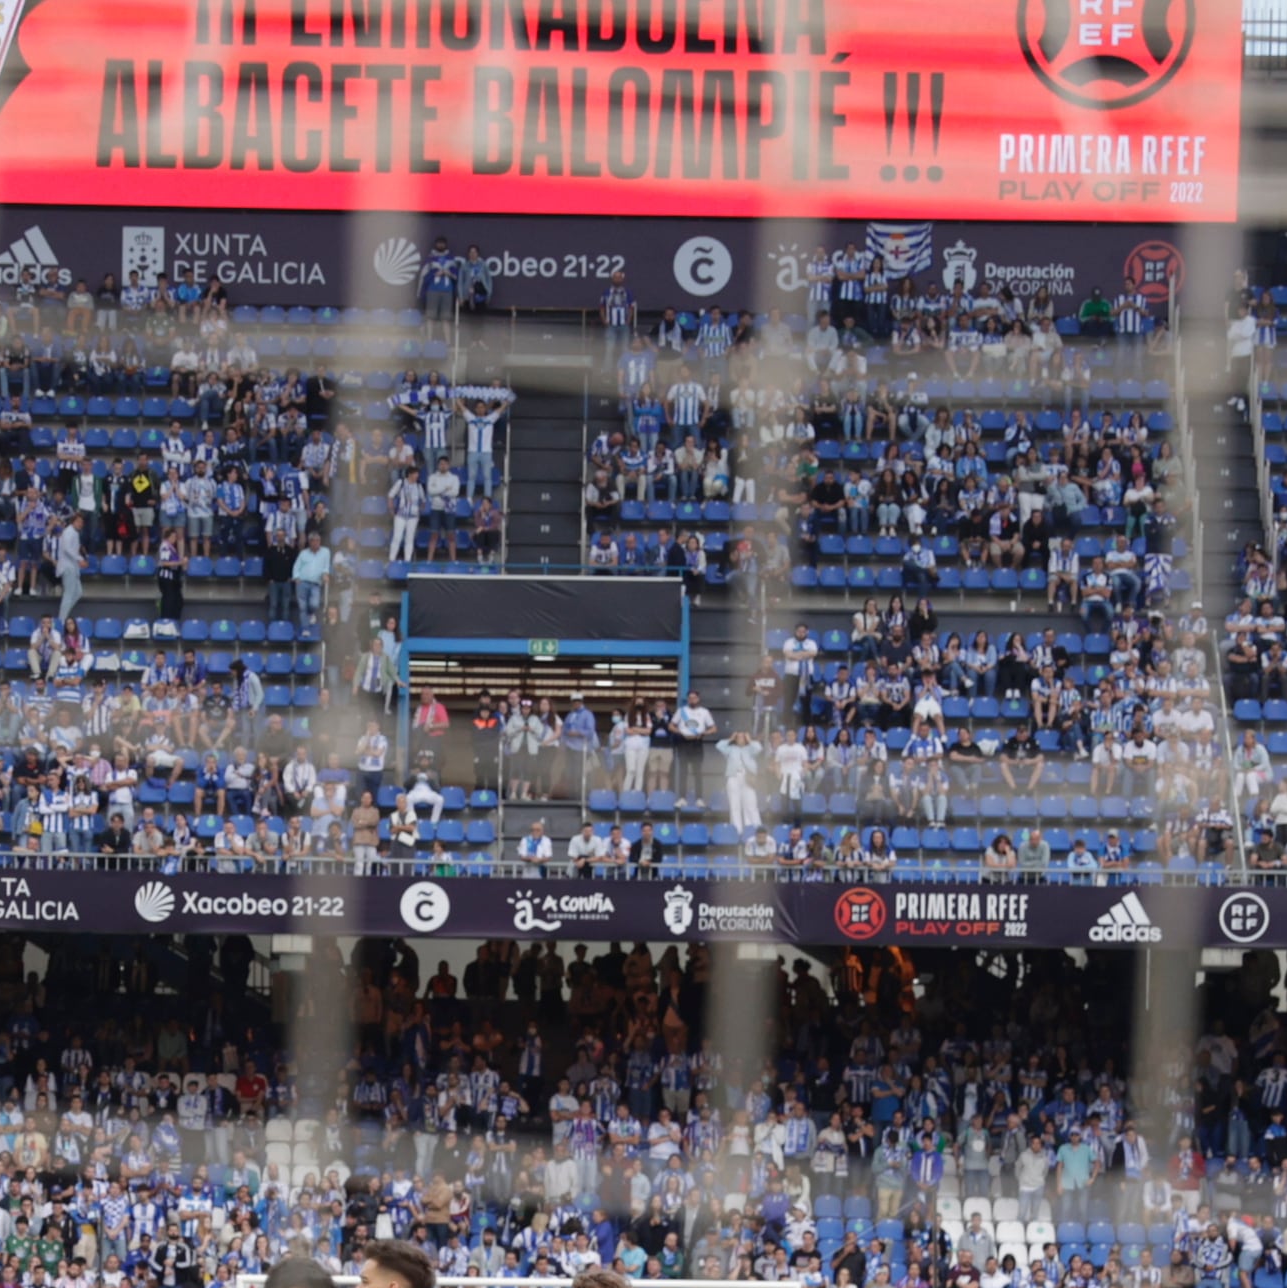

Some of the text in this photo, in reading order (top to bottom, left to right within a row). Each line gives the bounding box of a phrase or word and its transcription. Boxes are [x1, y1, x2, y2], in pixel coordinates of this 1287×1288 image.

[1079, 23, 1135, 45] EF
[97, 53, 944, 182] ALBACETE BALOMPIÉ !!!
[999, 133, 1206, 175] PRIMERA RFEF
[998, 180, 1204, 203] PLAY OFF 2022
[174, 232, 269, 257] XUNTA
[174, 260, 326, 286] DE GALICIA
[984, 262, 1074, 281] Deputación
[1010, 277, 1074, 296] CORÑA
[181, 889, 288, 916] Xacobeo
[542, 895, 558, 911] A
[698, 902, 774, 922] Deputación
[895, 892, 1029, 921] PRIMERA RFEF
[1231, 904, 1257, 916] RF
[698, 915, 774, 932] DA CORUÑA
[895, 922, 1028, 937] PLAY OFF 2022
[1088, 921, 1162, 943] adidas
[1231, 918, 1257, 931] EF
